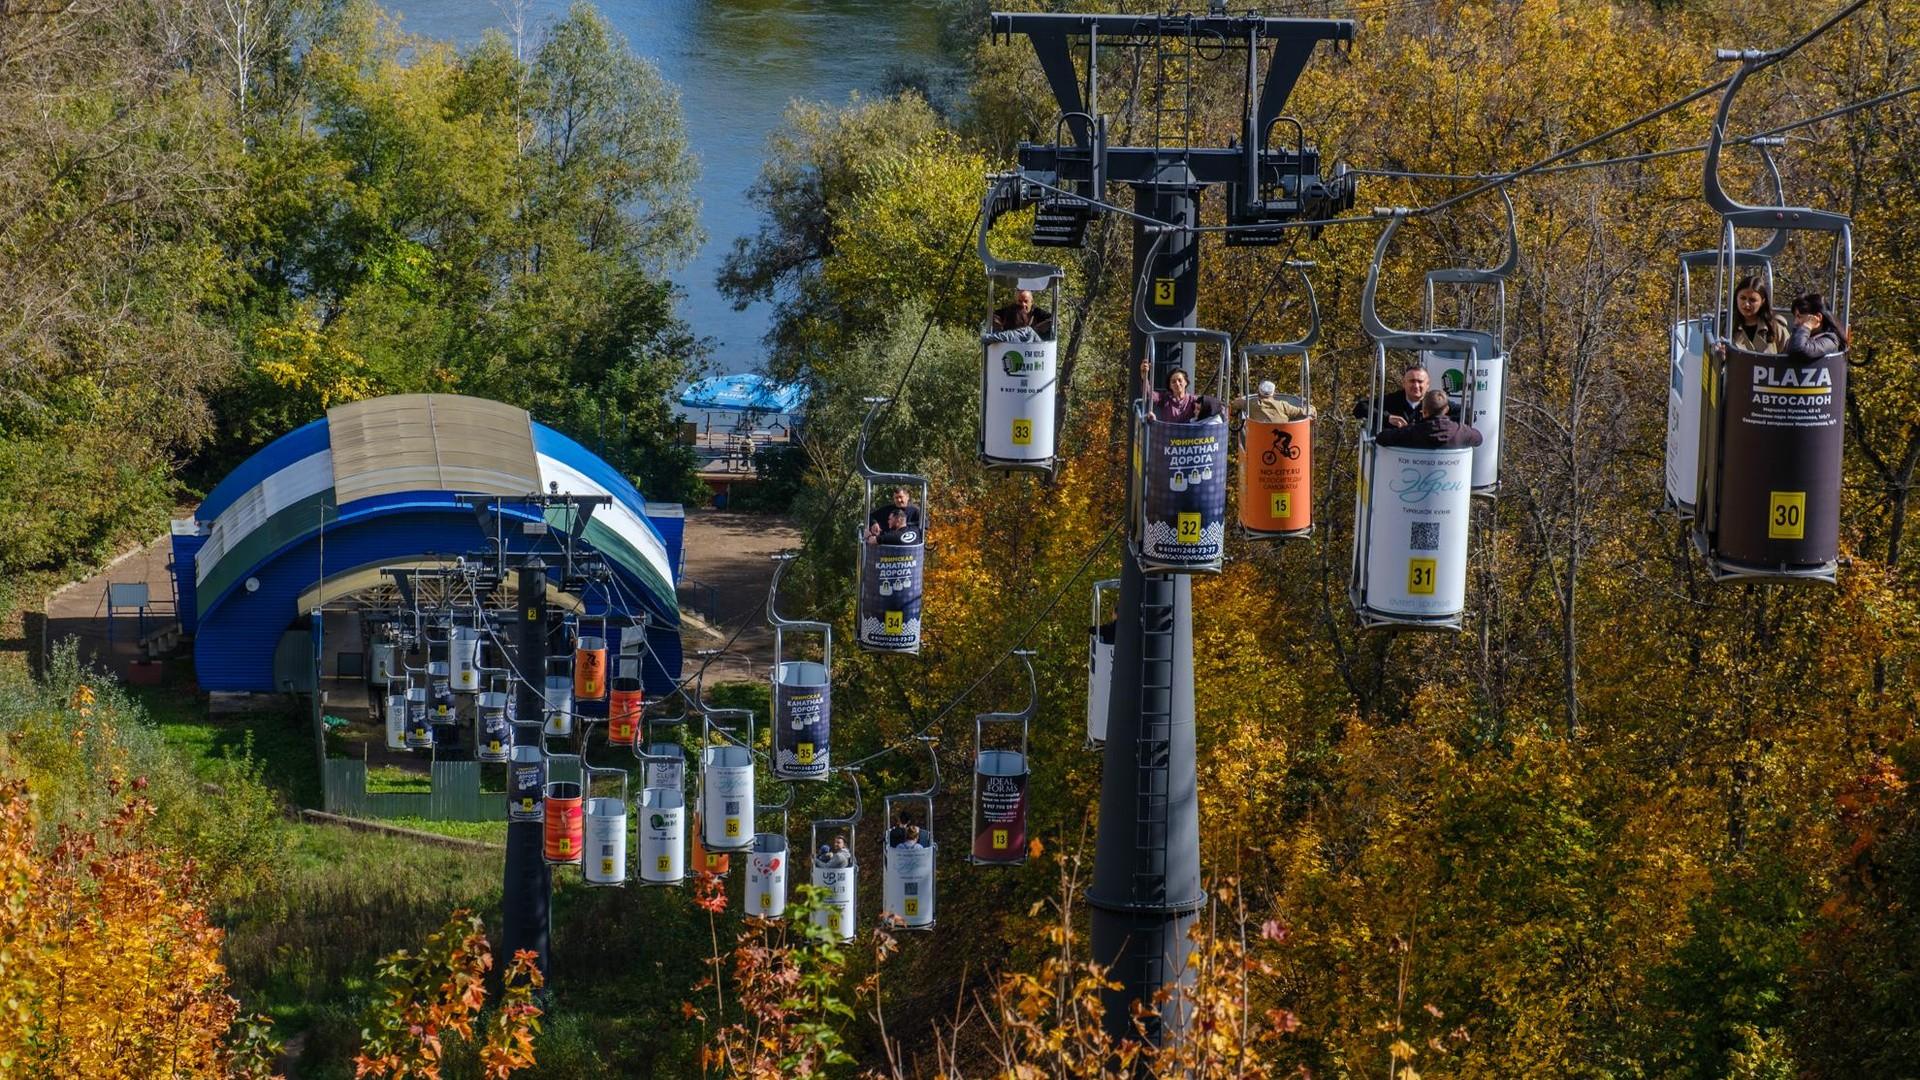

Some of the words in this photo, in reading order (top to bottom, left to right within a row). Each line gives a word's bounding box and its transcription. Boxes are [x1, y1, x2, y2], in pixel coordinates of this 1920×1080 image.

[1160, 282, 1170, 300] 3
[1753, 366, 1832, 386] PLAZA
[1752, 394, 1831, 405] АВТОСАЛОН
[1015, 426, 1029, 438] 33
[1170, 436, 1215, 446] УФИНСКАЯ
[1164, 442, 1219, 456] КАНАТНАЯ
[1170, 454, 1213, 466] ДОРОГА
[1275, 499, 1287, 512] 15
[1775, 505, 1799, 526] 30
[1182, 520, 1197, 536] 32
[875, 560, 917, 570] КАНАТНАЯ
[879, 568, 912, 577] ДОРОГА
[1413, 568, 1431, 586] 31
[530, 610, 535, 618] 2
[888, 617, 900, 629] 34
[787, 697, 824, 707] КАНАТНАЯ
[791, 706, 820, 714] ДОРОГА
[801, 749, 811, 758] 35
[990, 777, 1014, 785] IDEAL
[987, 784, 1018, 792] FORMS
[727, 823, 737, 833] 36
[996, 835, 1006, 844] 13
[907, 903, 915, 912] 12
